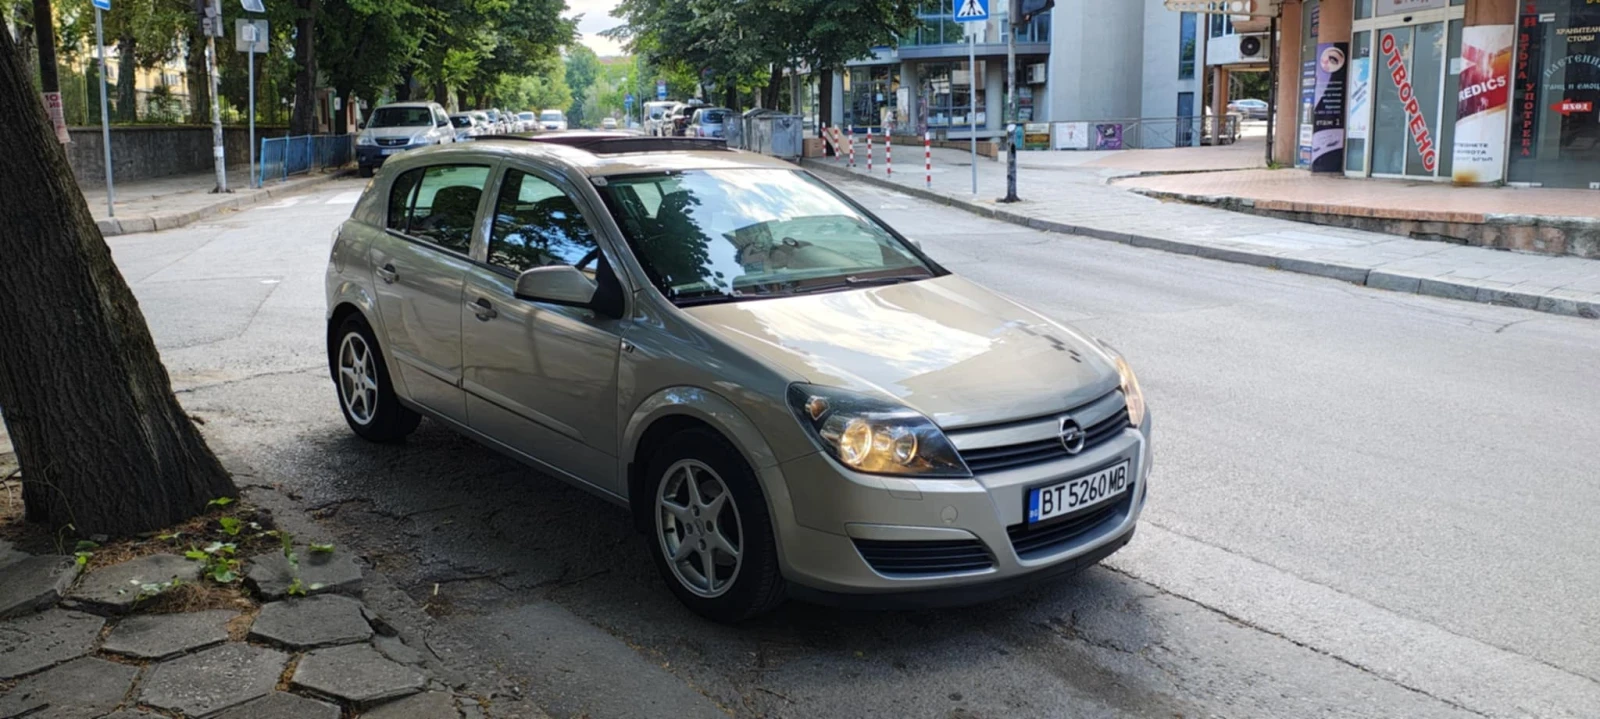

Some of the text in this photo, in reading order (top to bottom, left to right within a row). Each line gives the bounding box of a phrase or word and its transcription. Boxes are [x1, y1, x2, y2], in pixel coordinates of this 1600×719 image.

[1518, 33, 1529, 79] ВТОРА
[1544, 54, 1600, 78] ПЛЕТЕНИ
[1381, 33, 1436, 171] ОТВОРЕНО
[1521, 82, 1535, 156] УПОТРЕБА
[1562, 103, 1588, 111] ВХОД
[1042, 465, 1126, 515] BT 5260 MB
